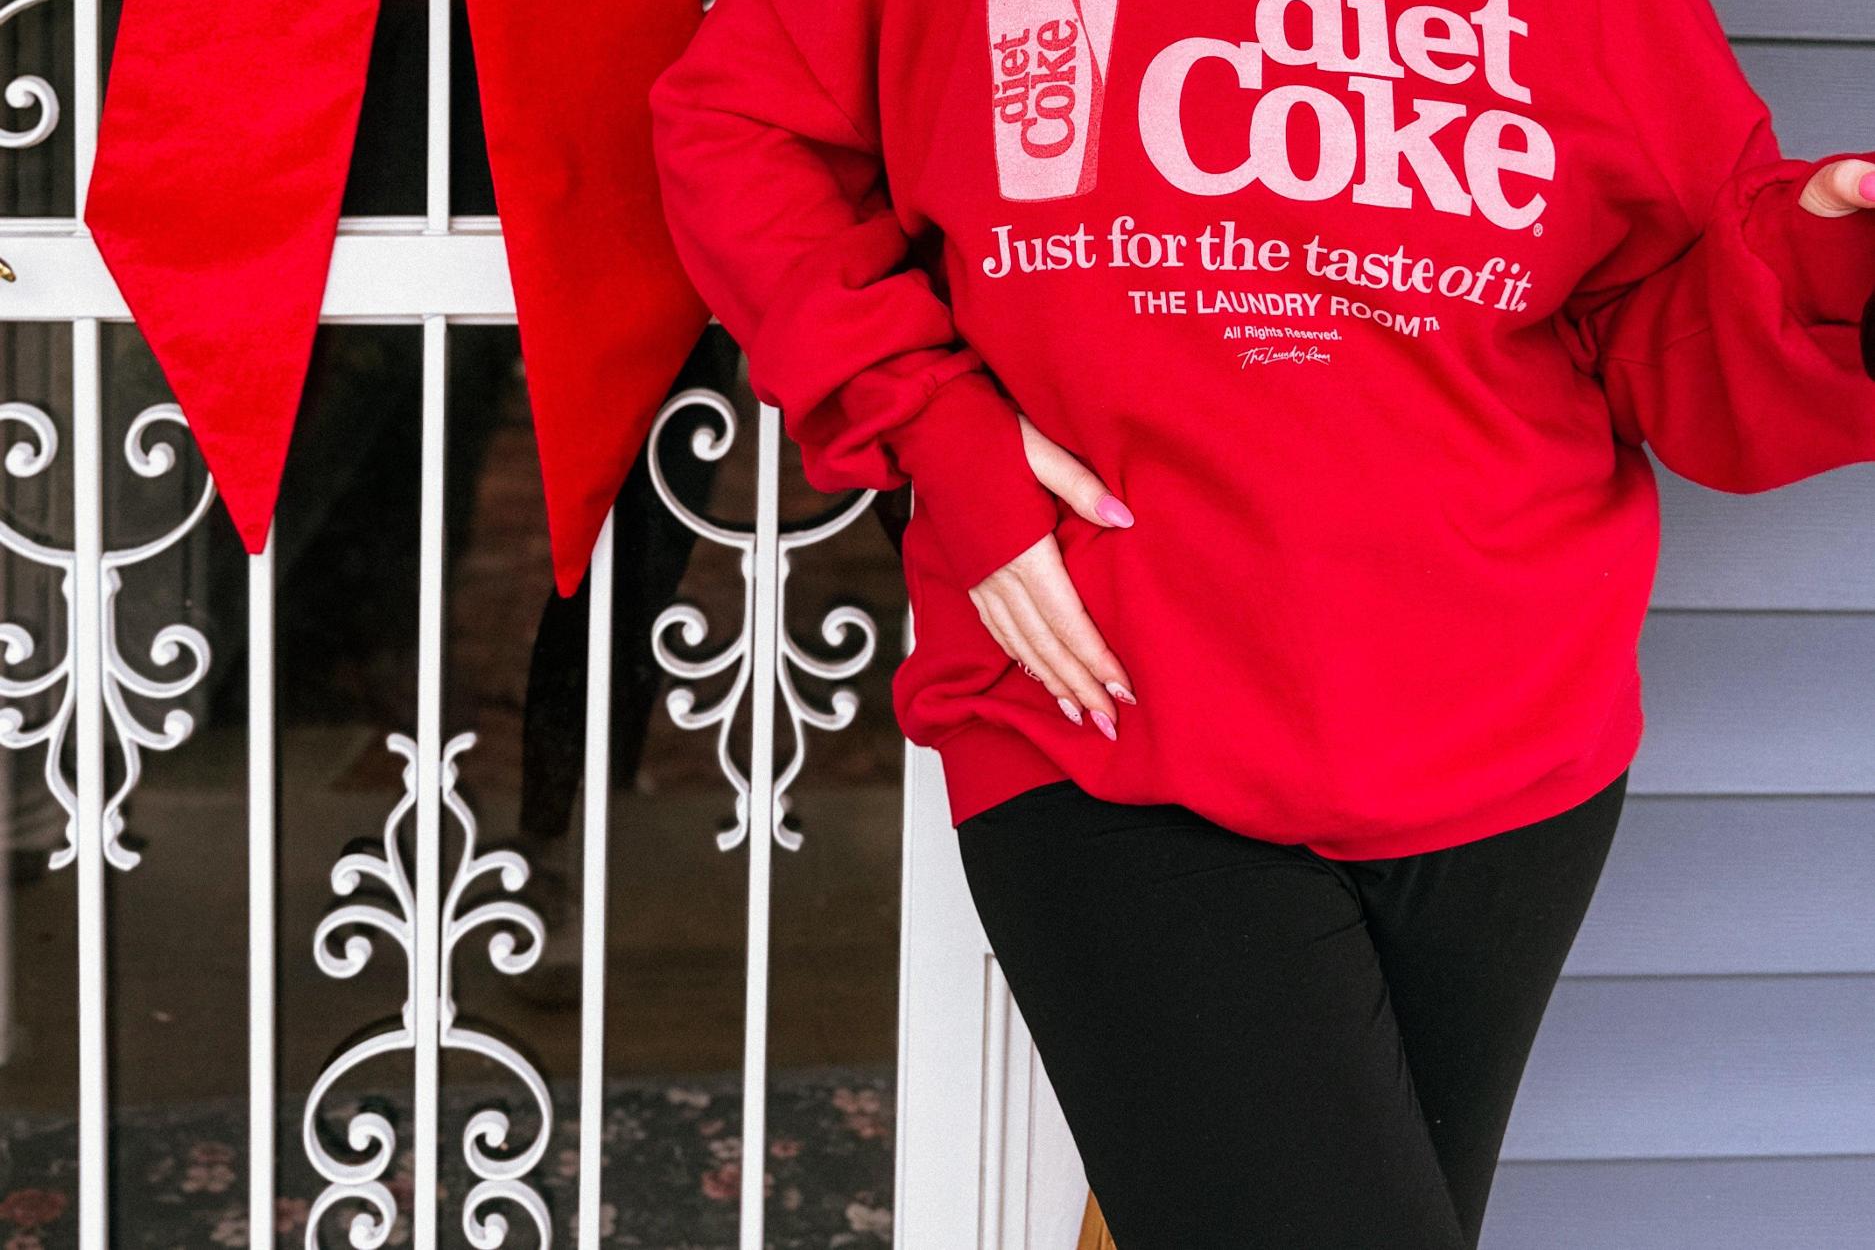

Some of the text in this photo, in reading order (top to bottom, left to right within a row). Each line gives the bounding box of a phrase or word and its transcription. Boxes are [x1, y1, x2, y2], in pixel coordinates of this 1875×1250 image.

[994, 28, 1031, 125] diet
[1019, 19, 1080, 159] Coke
[982, 215, 1532, 312] Just for the taste of it.
[1127, 291, 1187, 315] THE
[1196, 290, 1322, 317] LAUNDRY
[1223, 325, 1342, 341] All Rights Reserved.
